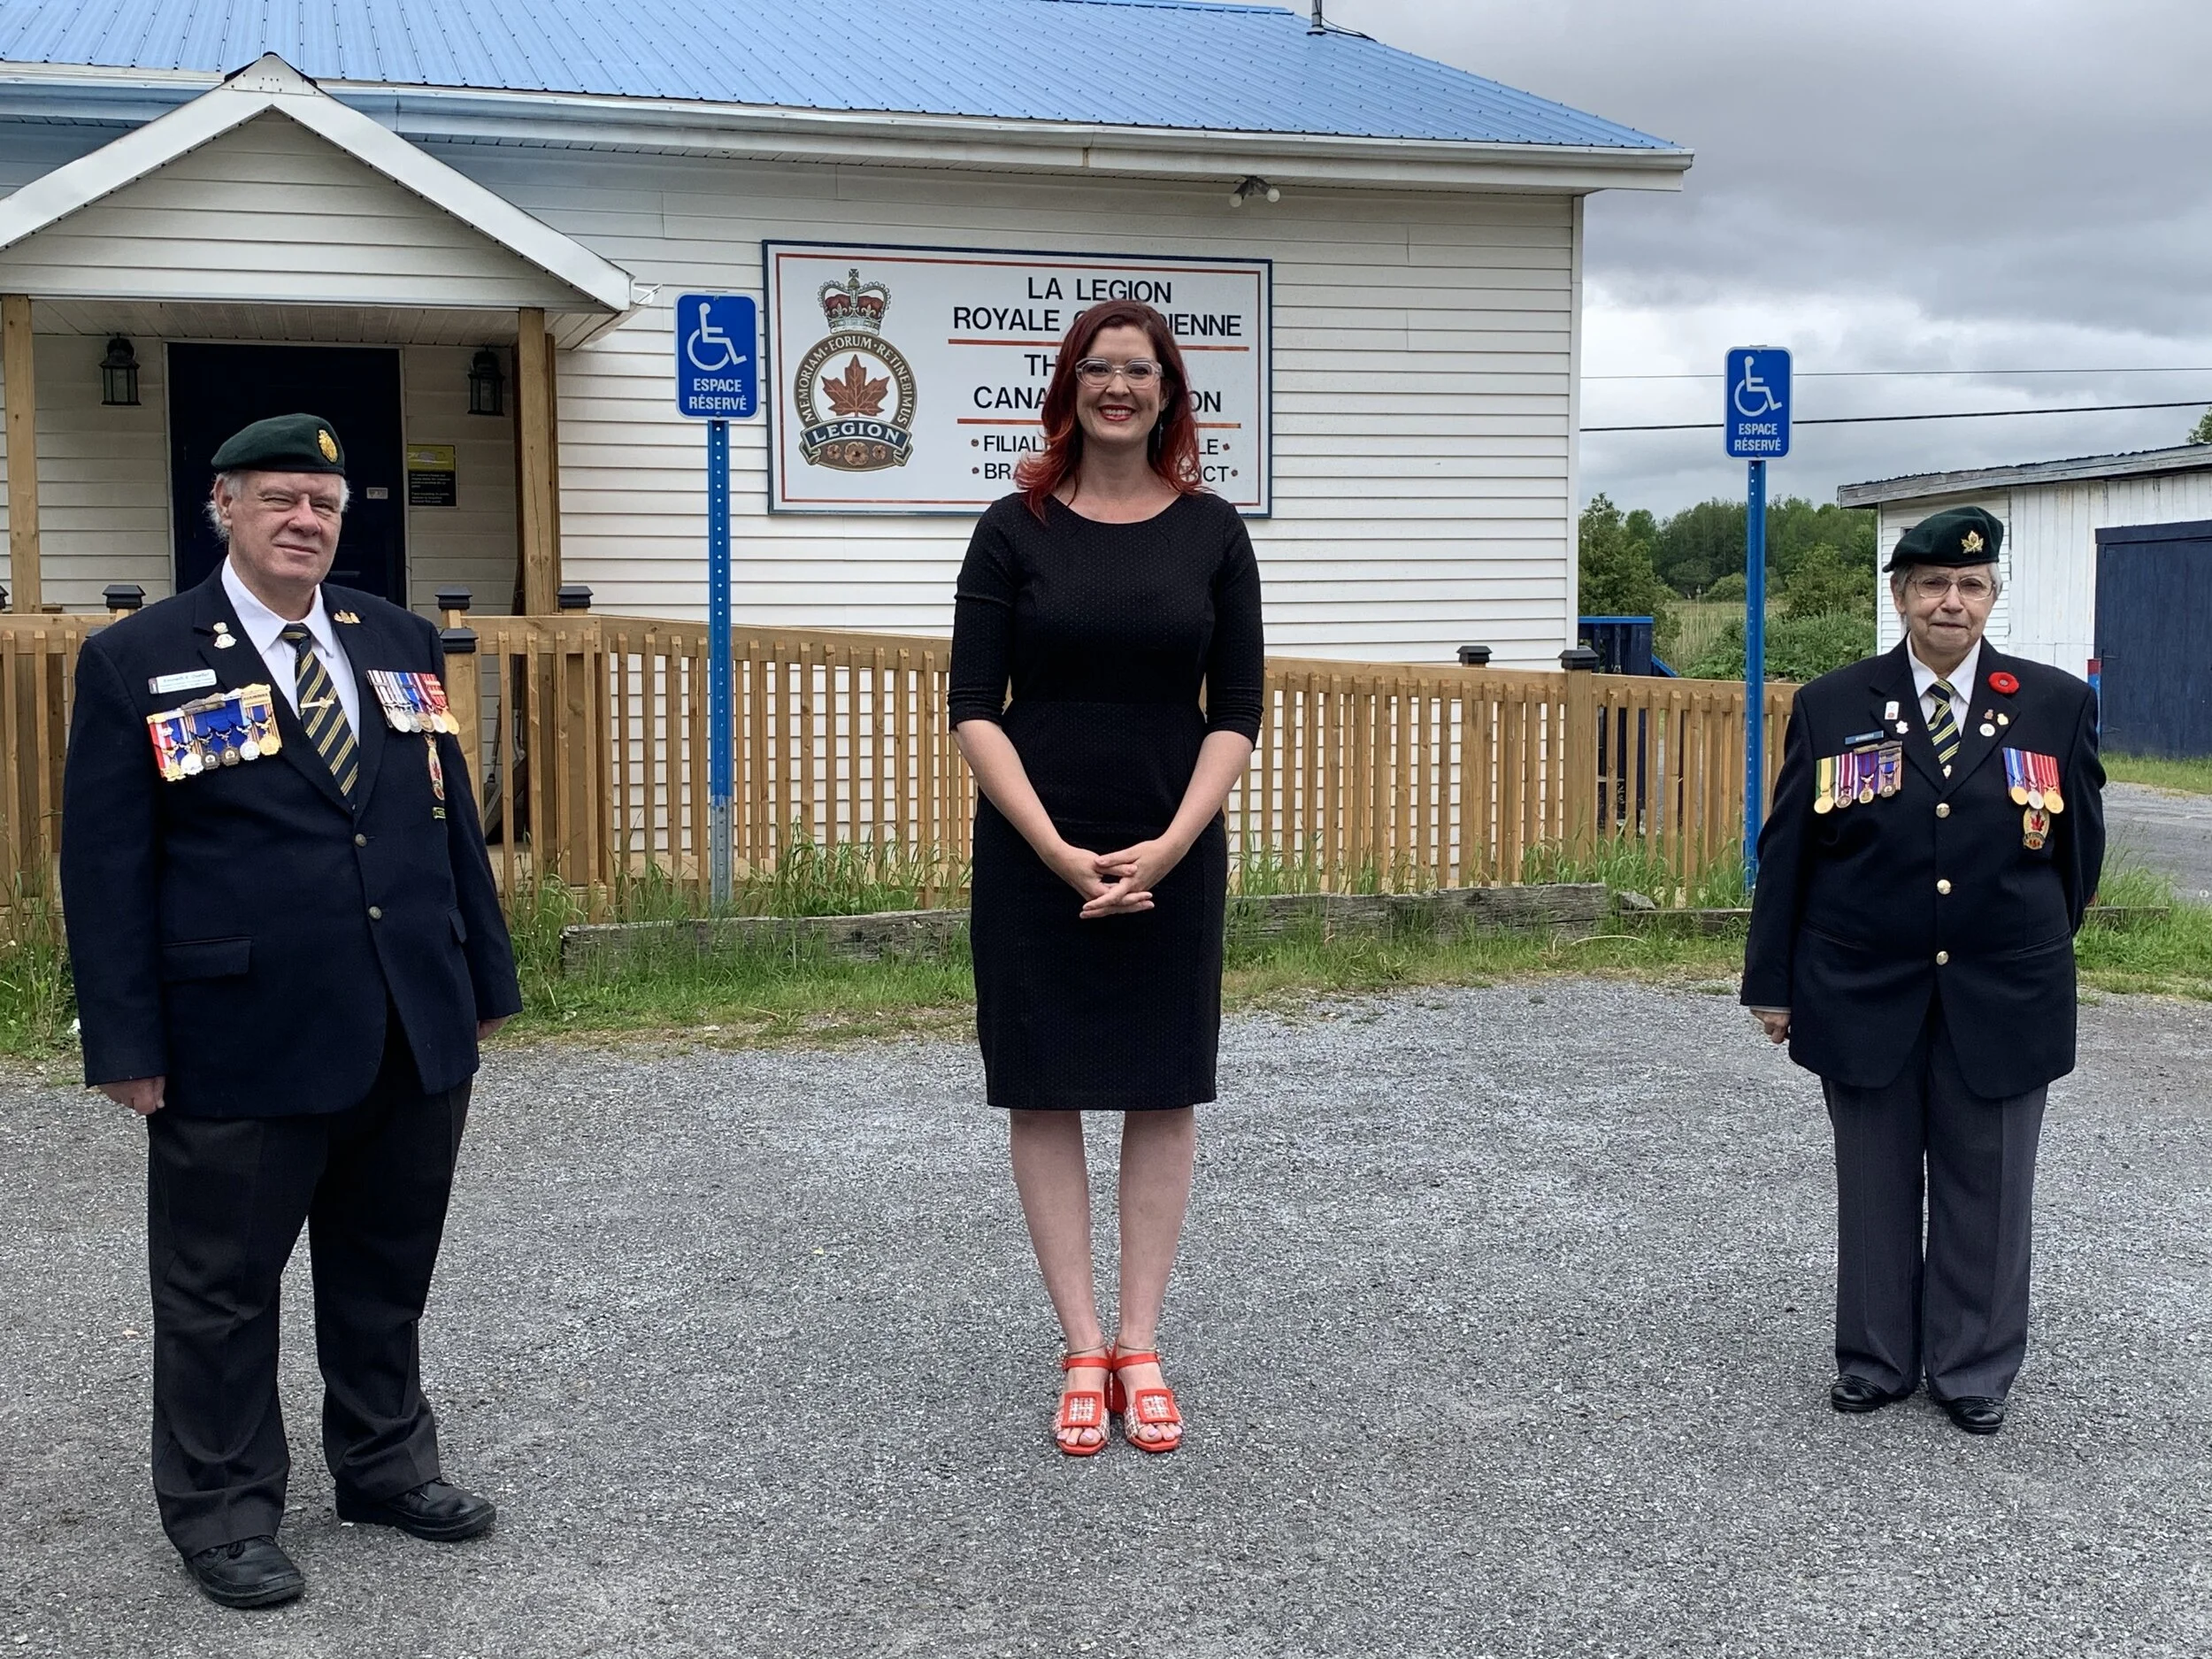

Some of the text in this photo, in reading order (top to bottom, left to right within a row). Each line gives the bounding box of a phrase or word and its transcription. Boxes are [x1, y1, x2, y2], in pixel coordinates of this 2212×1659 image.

[1027, 277, 1172, 303] LA LEGION
[953, 306, 1061, 332] ROYALE
[1024, 354, 1059, 376] TH
[693, 378, 742, 393] ESPACE
[798, 335, 913, 426] MEMORIAM EORUM RETINEBIMUS
[688, 394, 748, 411] RÉSERVÉ
[973, 386, 1048, 410] CANA
[811, 421, 900, 443] LEGION
[1738, 423, 1778, 435] ESPACE
[983, 434, 1048, 452] FILIAL
[1733, 437, 1782, 451] RÉSERVÉ
